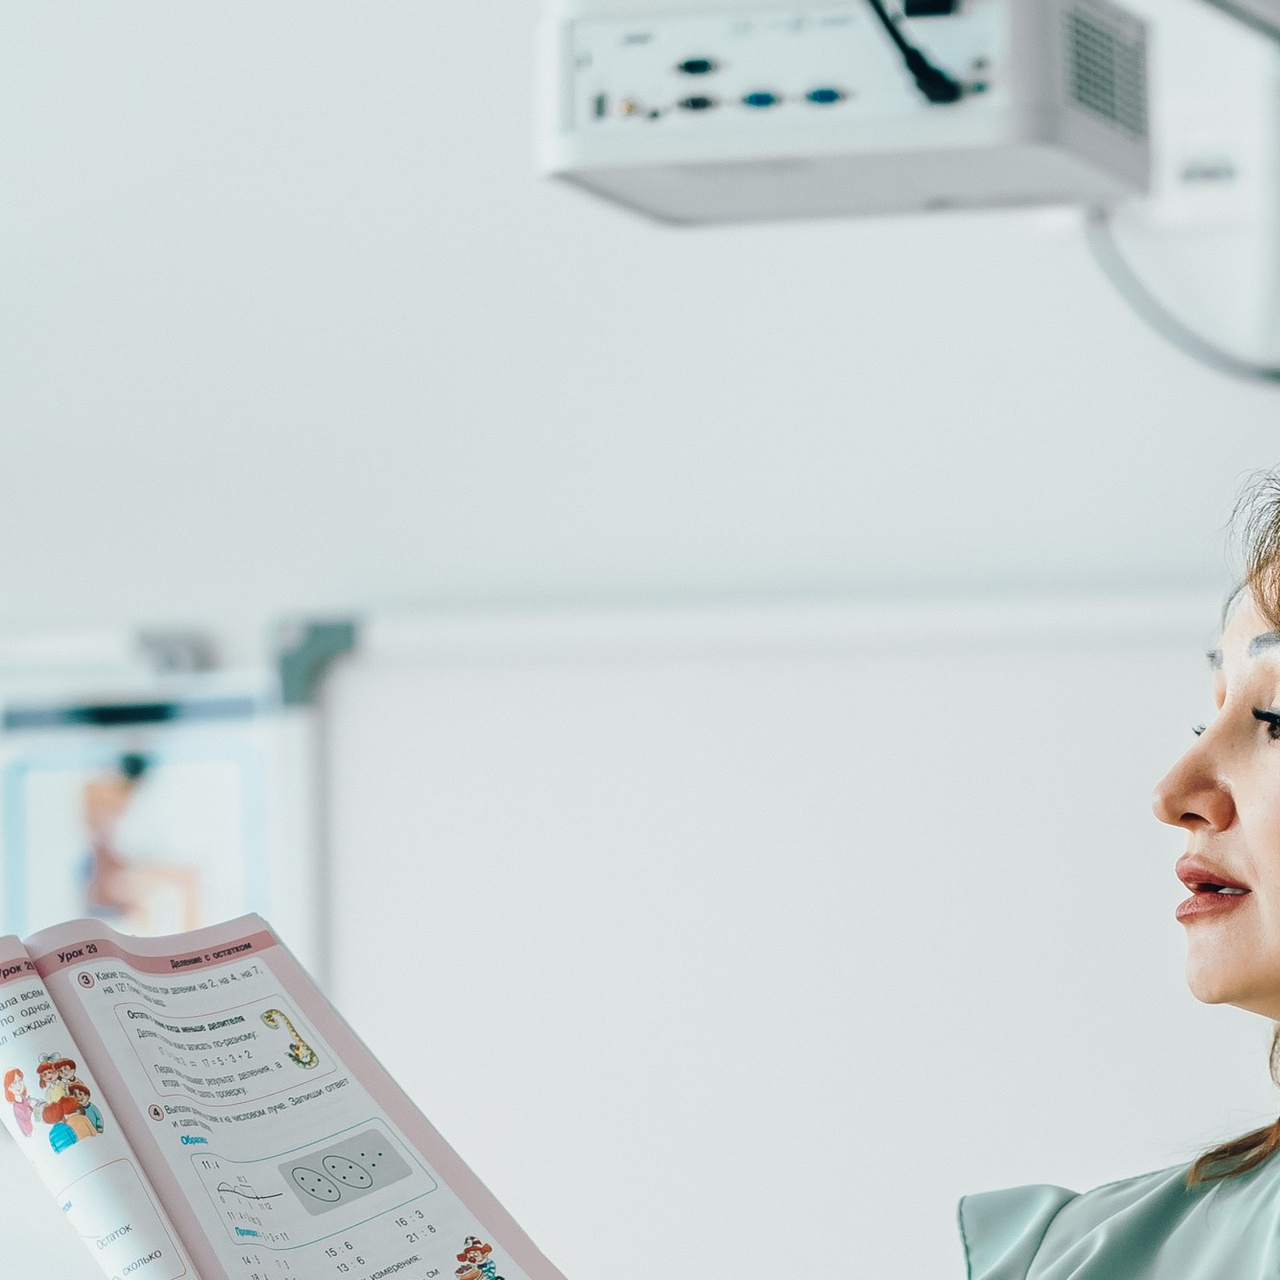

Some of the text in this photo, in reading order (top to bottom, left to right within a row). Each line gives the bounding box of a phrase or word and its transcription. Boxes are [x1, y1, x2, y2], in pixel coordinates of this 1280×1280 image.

[57, 944, 98, 963] Урок 29
[170, 956, 203, 969] Деление
[212, 942, 252, 959] остатком
[81, 975, 91, 985] 3
[198, 982, 209, 991] на
[240, 970, 253, 979] на
[20, 989, 44, 1001] всем
[102, 986, 114, 995] на
[20, 1000, 52, 1017] одной
[12, 1013, 57, 1038] каждый?
[207, 1015, 245, 1031] делителя
[228, 1054, 237, 1063] 3
[244, 1050, 253, 1059] 2
[274, 1061, 283, 1070] а
[231, 1109, 266, 1122] числовом
[266, 1102, 289, 1114] луче.
[288, 1088, 323, 1106] Запиши
[324, 1077, 350, 1093] ответ
[395, 1217, 408, 1228] 16
[415, 1210, 424, 1219] 3
[96, 1223, 133, 1250] Остаток
[406, 1233, 420, 1243] 21
[427, 1224, 436, 1234] 8
[325, 1247, 338, 1258] 15
[344, 1241, 353, 1251] 6
[122, 1250, 162, 1276] сколько
[336, 1262, 349, 1273] 13
[356, 1256, 365, 1265] 6
[370, 1254, 422, 1280] измерения:
[426, 1268, 441, 1278] см
